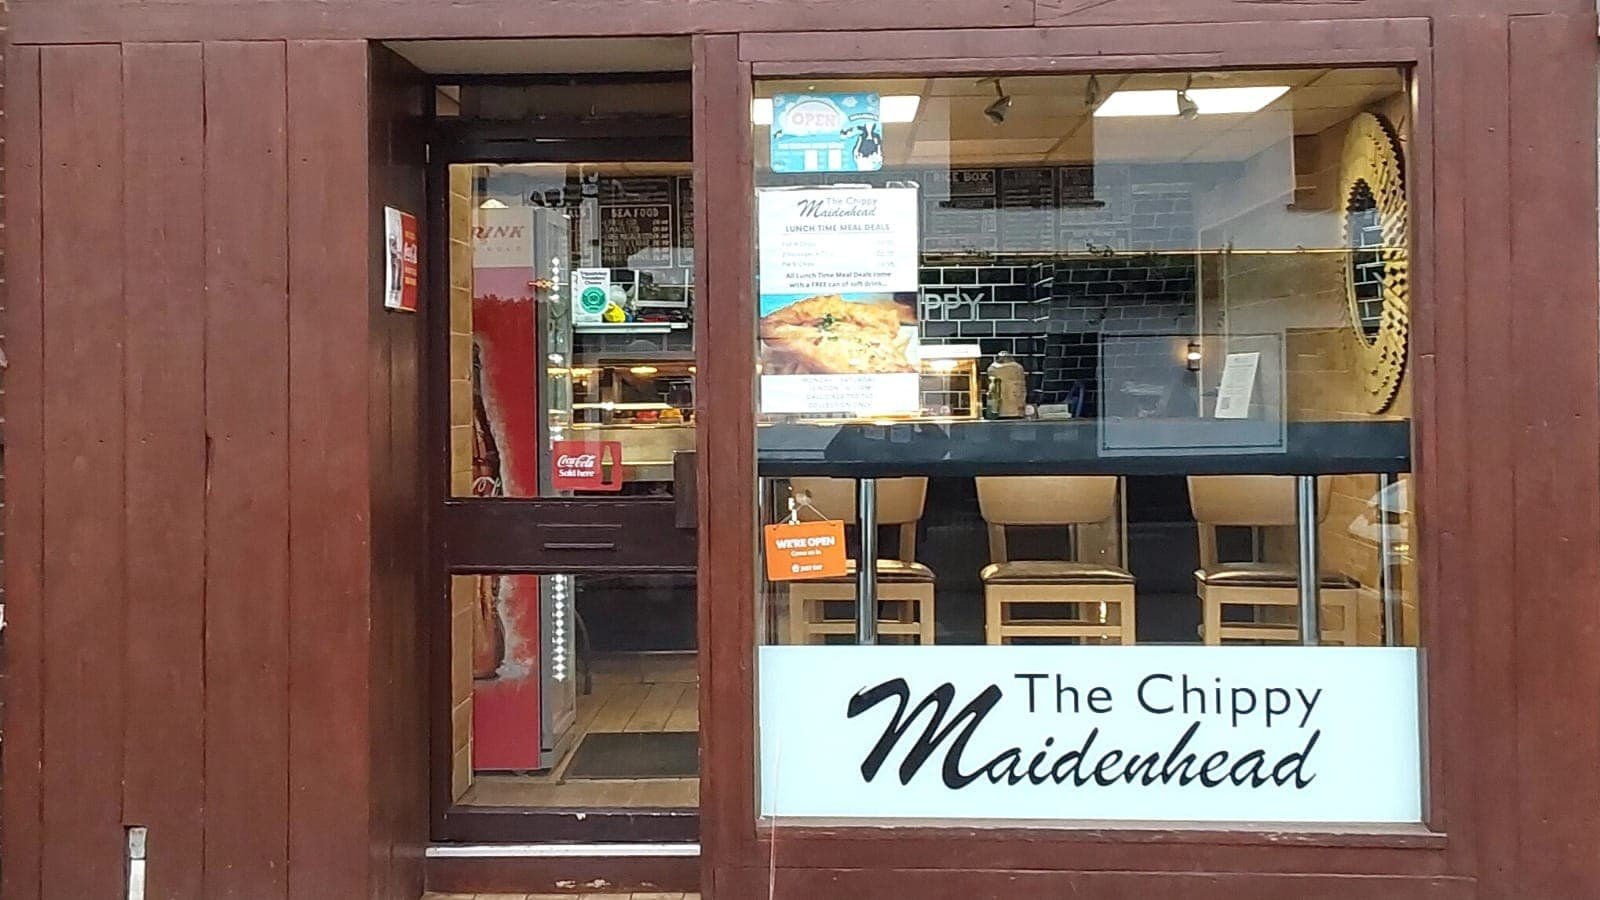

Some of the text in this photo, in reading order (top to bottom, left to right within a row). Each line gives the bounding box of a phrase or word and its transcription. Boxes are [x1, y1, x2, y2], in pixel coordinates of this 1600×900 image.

[791, 111, 837, 127] OPEN
[963, 171, 989, 182] BOX
[826, 196, 878, 206] The Chippy
[797, 199, 877, 218] Maidenhead
[785, 225, 815, 233] LUNCH
[817, 224, 837, 232] TIME
[864, 223, 890, 231] DEALS
[558, 469, 596, 478] Sold here
[775, 536, 836, 549] WE'RE OPEN
[1014, 673, 1323, 728] The Chippy
[846, 677, 1321, 790] Maidenhead
